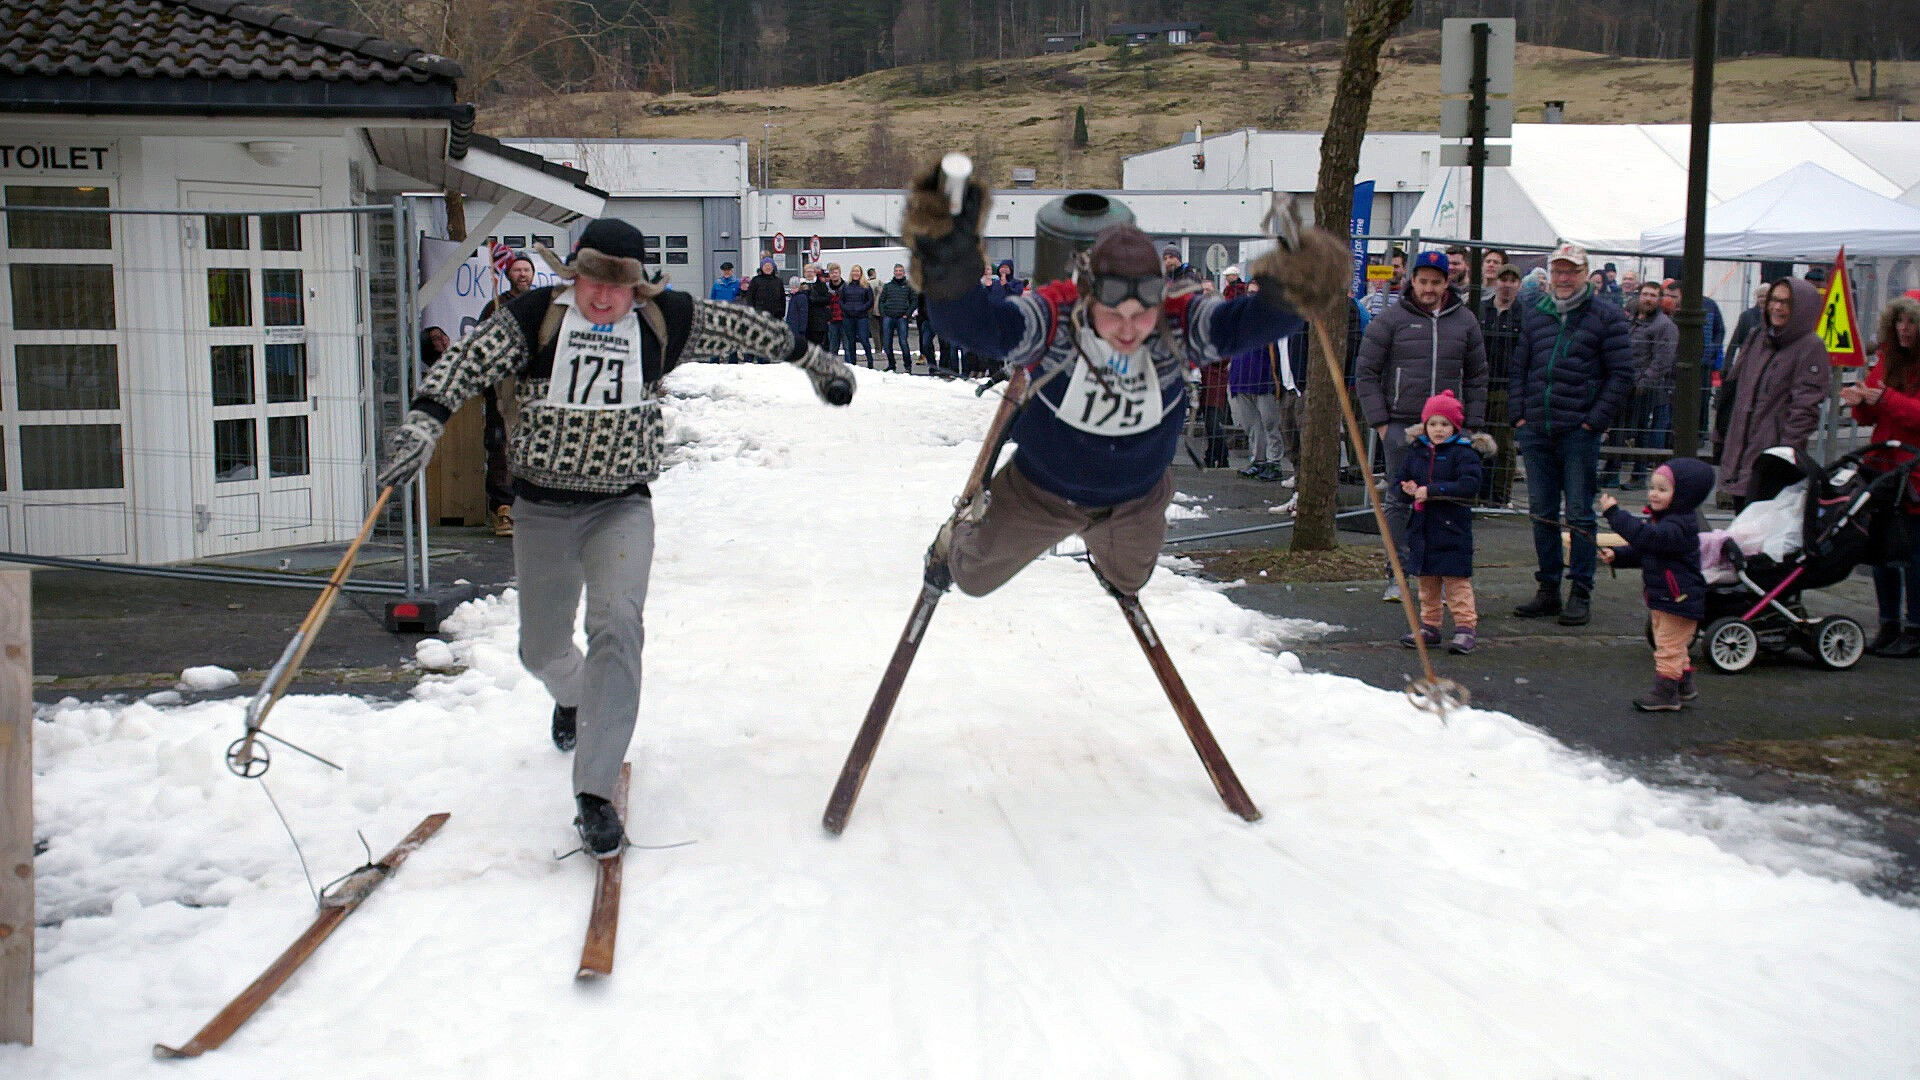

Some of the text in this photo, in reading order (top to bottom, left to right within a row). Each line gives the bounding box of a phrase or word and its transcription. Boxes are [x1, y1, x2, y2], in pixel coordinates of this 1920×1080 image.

[0, 145, 109, 170] TOILET
[567, 354, 624, 404] 173
[1081, 391, 1145, 427] 175
